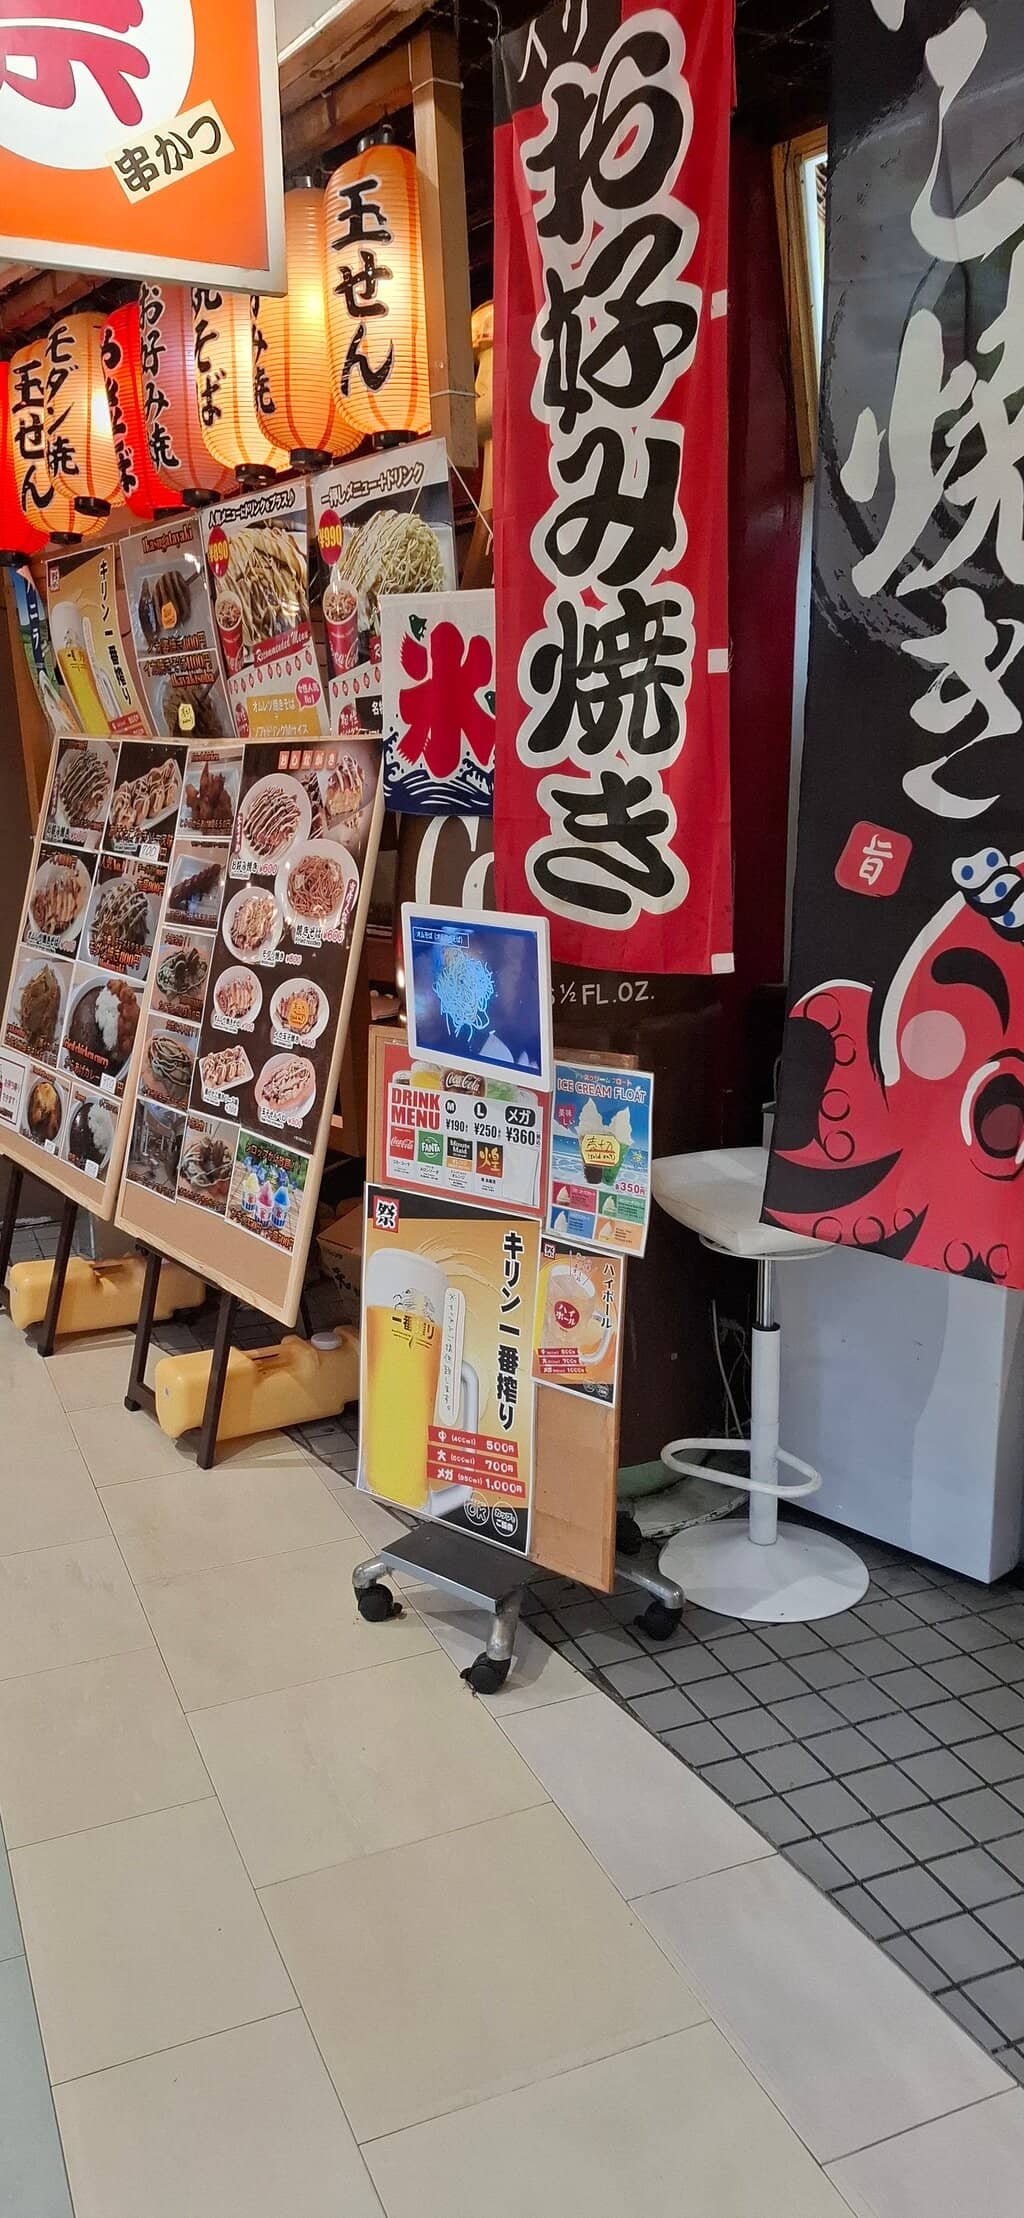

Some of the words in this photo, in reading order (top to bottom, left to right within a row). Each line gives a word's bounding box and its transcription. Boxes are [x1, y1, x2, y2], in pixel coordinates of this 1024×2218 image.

[113, 113, 223, 193] 串かつ
[331, 176, 394, 396] 玉せん
[46, 326, 80, 477] モダン焼
[12, 361, 55, 512] 玉せん
[526, 30, 699, 916] お好み焼き
[319, 525, 342, 549] ¥990
[398, 620, 495, 779] 氷
[862, 834, 894, 885] 旨
[392, 1088, 440, 1110] DRINK
[557, 1078, 574, 1092] ICE
[575, 1082, 612, 1098] CREAM
[613, 1085, 647, 1104] FLOAT
[392, 1105, 440, 1131] MENU
[446, 1119, 465, 1132] ¥190
[507, 1108, 531, 1124] メガ
[474, 1122, 497, 1138] ¥250
[506, 1126, 536, 1146] ¥360
[479, 1147, 500, 1172] 煌
[377, 1203, 396, 1227] 祭
[601, 1264, 615, 1328] ハイボール
[497, 1231, 524, 1430] キリン一番搾り
[438, 1430, 447, 1442] 中
[486, 1440, 514, 1453] 500円
[437, 1449, 446, 1462] 大
[485, 1459, 514, 1473] 700円
[437, 1468, 453, 1481] メガ
